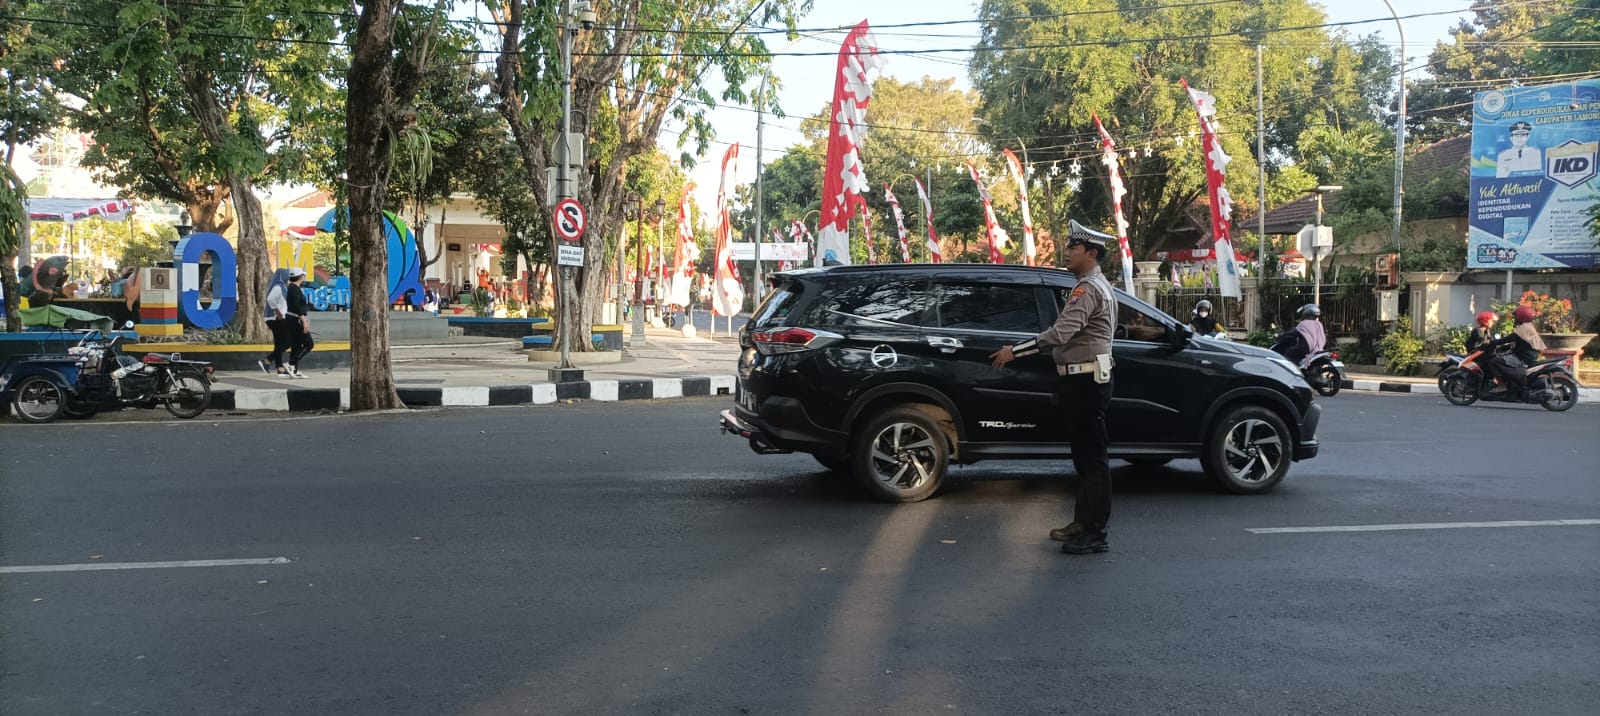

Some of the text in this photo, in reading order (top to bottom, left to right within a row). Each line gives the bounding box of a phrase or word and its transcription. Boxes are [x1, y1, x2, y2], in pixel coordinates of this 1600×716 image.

[1535, 115, 1572, 125] KABUPATEN
[1553, 157, 1589, 173] IKD
[1480, 179, 1543, 198] Yuk Aktivasi!
[1478, 198, 1511, 207] IDENTITAS
[1478, 203, 1532, 213] KEPENDUDUKAN
[1478, 212, 1504, 220] DIGITAL
[267, 240, 314, 282] M
[301, 285, 353, 312] ngan
